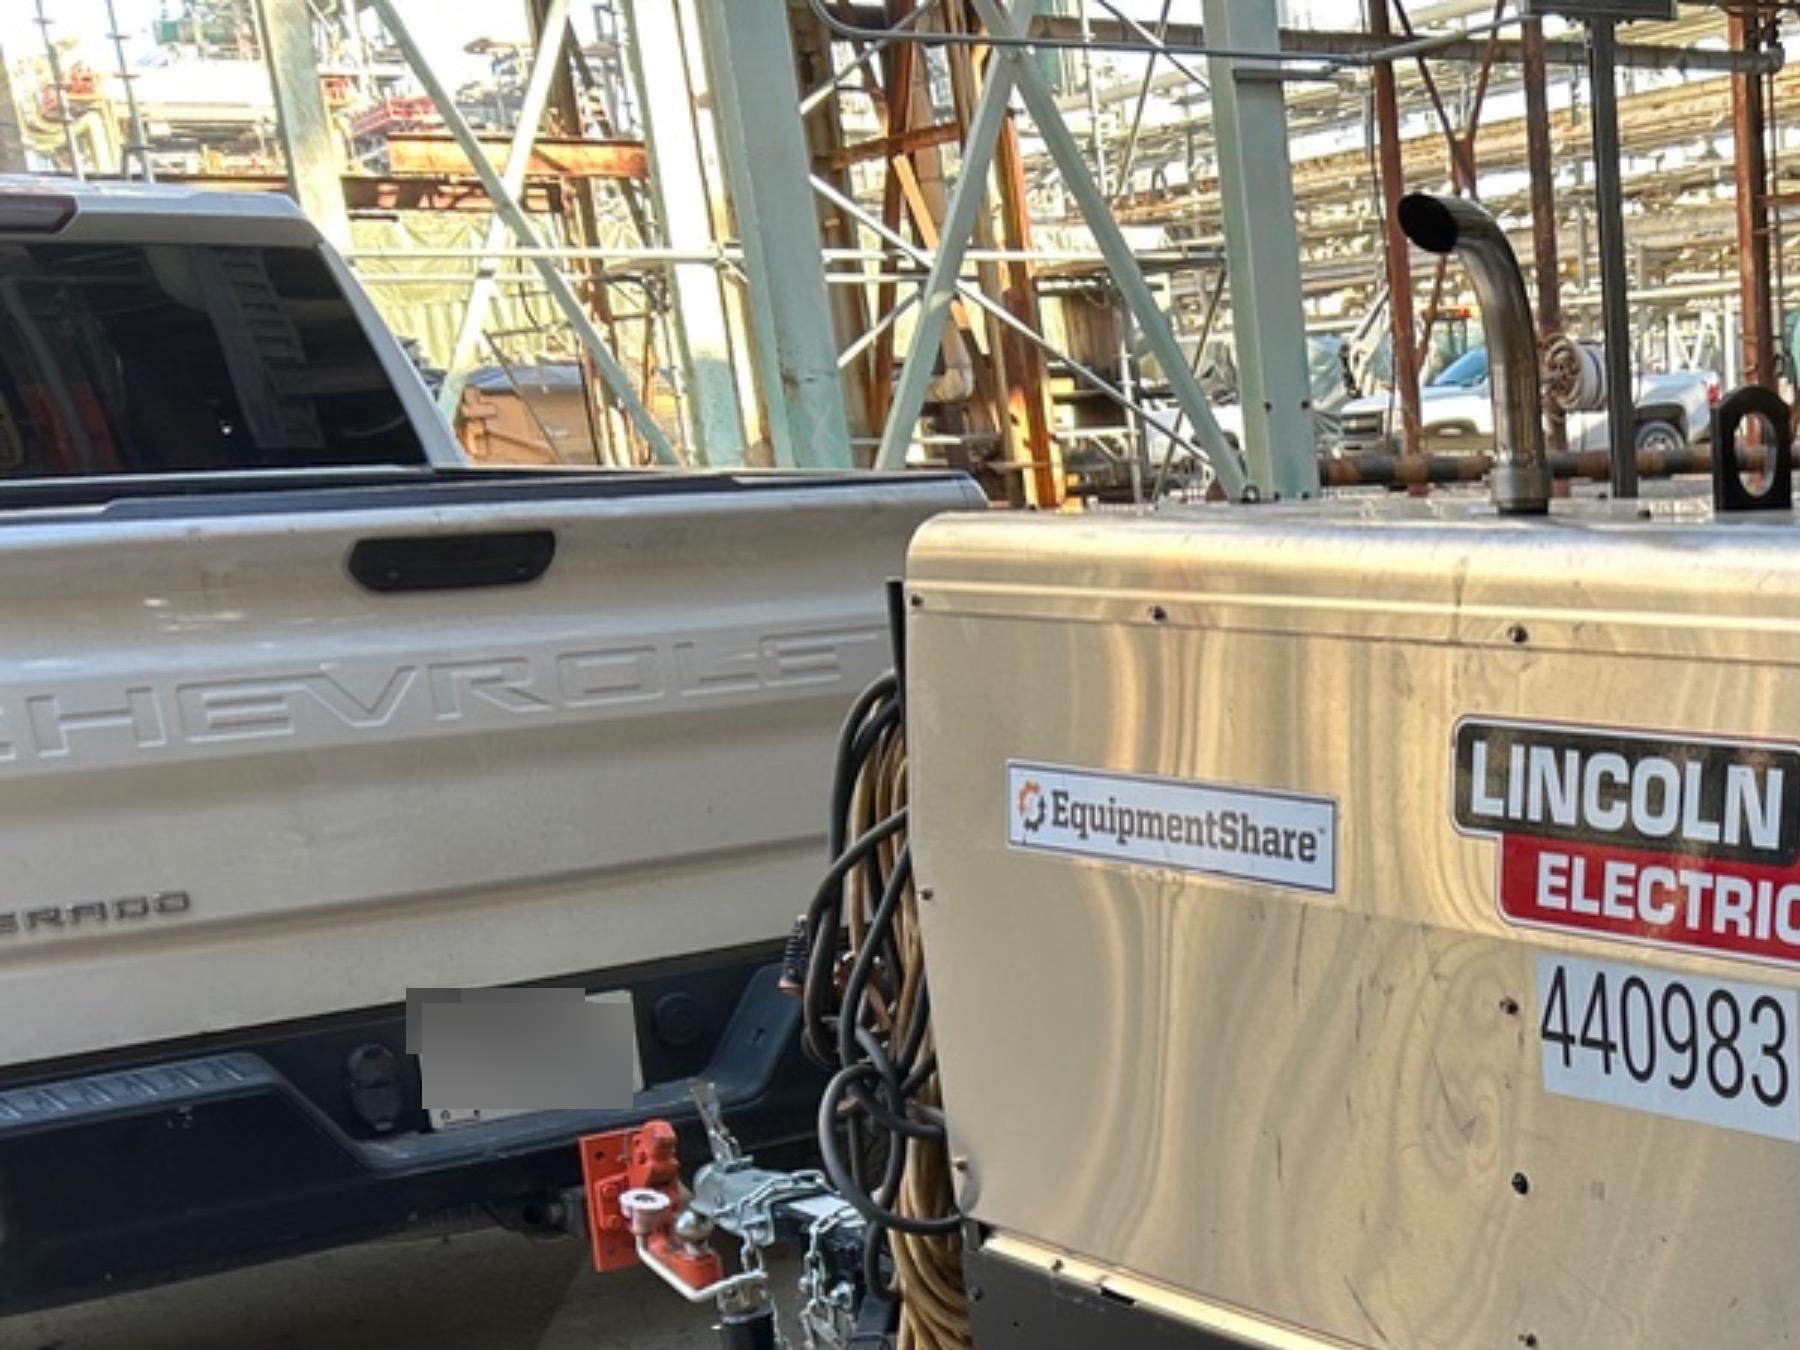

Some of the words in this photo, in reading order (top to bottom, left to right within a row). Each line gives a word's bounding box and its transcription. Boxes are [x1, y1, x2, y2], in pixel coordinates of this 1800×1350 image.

[1052, 790, 1318, 864] EquipmentShare
[1470, 740, 1784, 850] LINCOLN
[1540, 965, 1790, 1108] 440983
